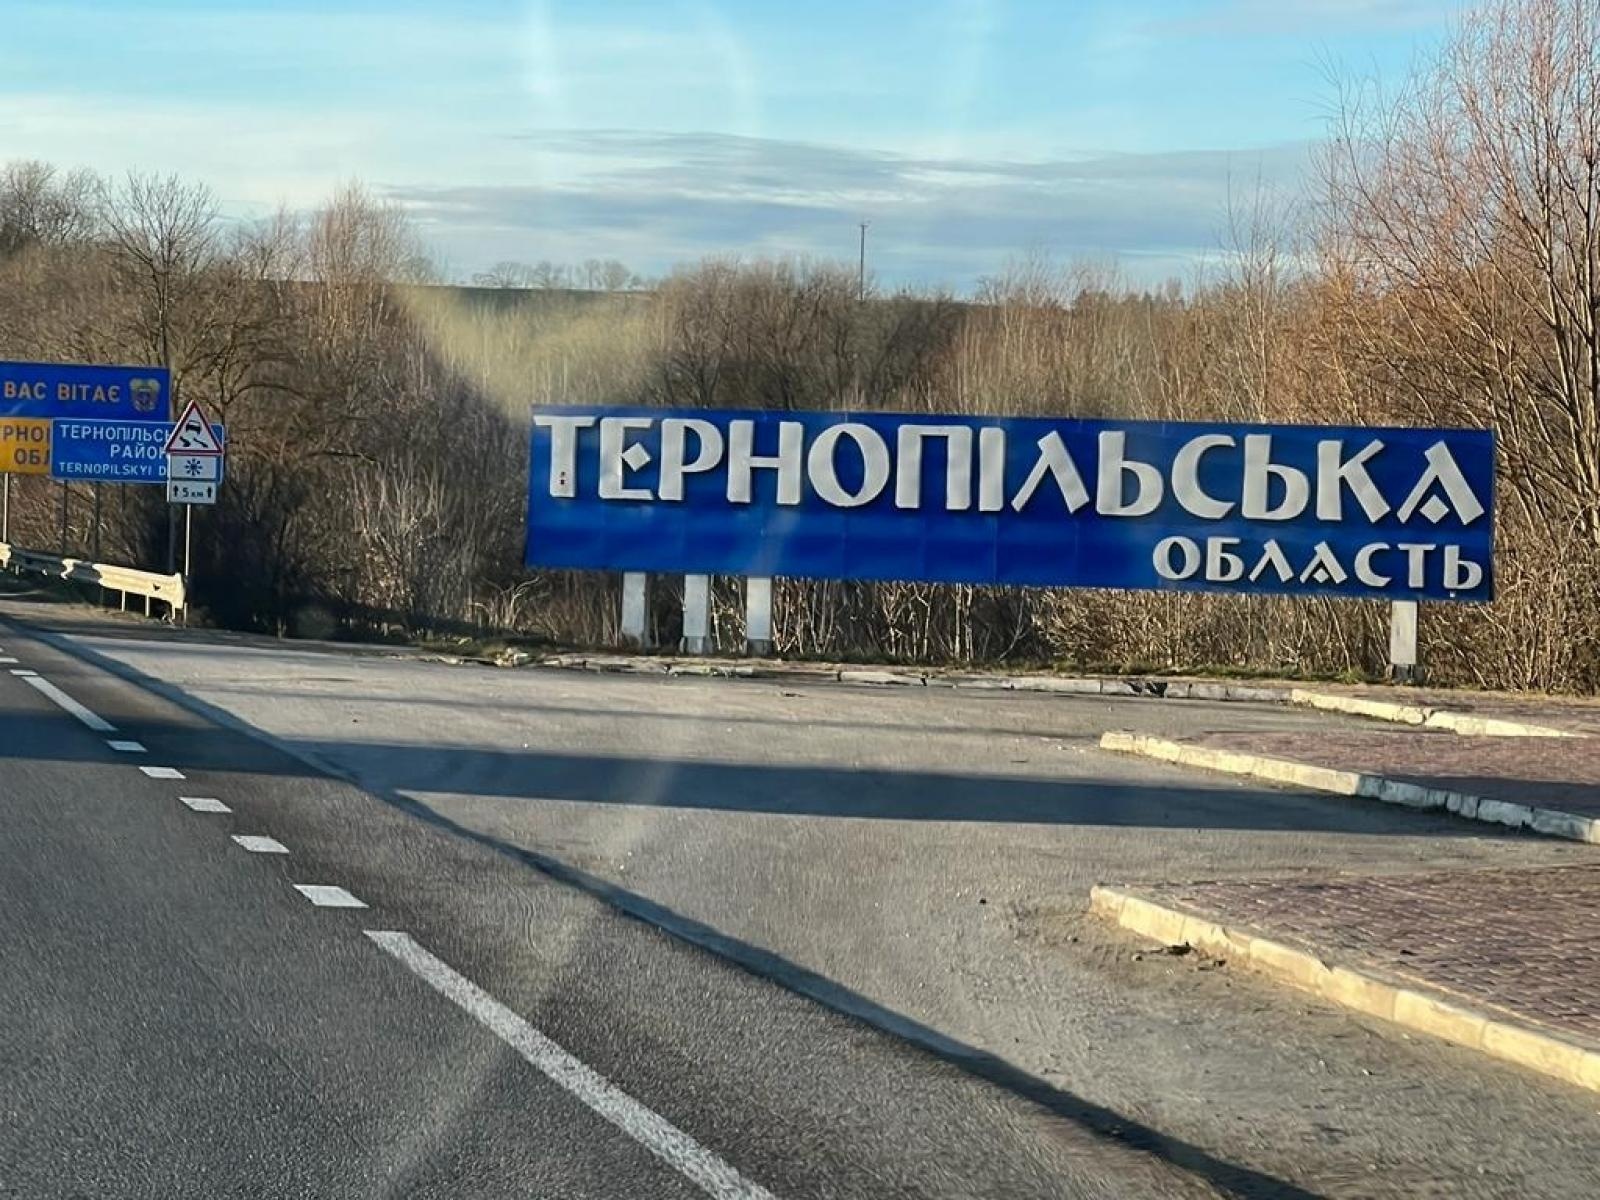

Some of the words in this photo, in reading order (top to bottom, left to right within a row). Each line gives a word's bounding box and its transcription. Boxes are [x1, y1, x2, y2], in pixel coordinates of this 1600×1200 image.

[4, 381, 47, 399] ВАС
[57, 383, 121, 402] ВІТАЄ
[3, 424, 50, 443] РНО
[59, 461, 152, 476] TERNOPILSKYI
[533, 415, 1485, 526] ТЕРНОПІЛЬСЬКА
[182, 487, 190, 498] 5
[1152, 535, 1483, 590] ОБЛАСТЬ
